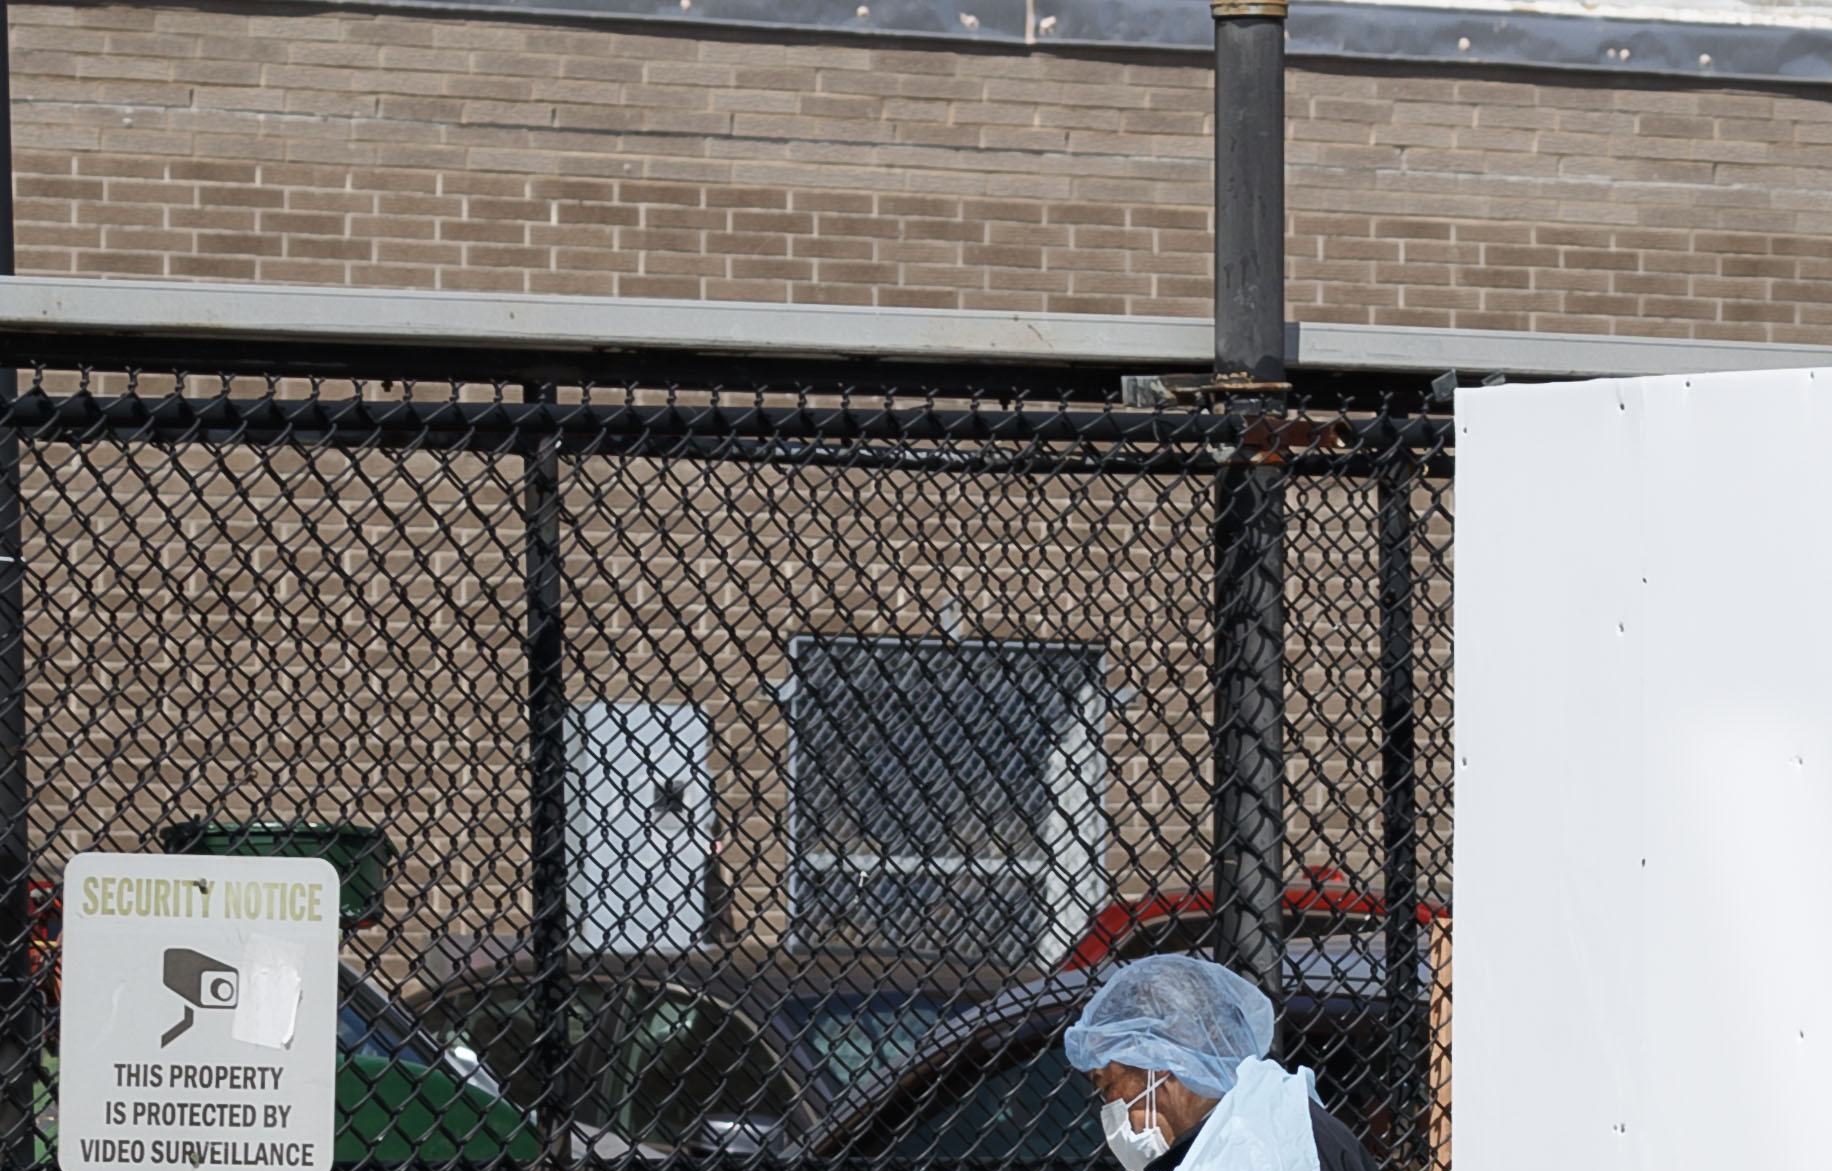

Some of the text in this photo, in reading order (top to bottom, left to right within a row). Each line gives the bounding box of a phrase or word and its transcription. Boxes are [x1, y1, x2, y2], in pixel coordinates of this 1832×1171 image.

[82, 877, 323, 921] SECURITY NOTICE
[114, 1064, 284, 1091] THIS PROPERTY
[105, 1101, 292, 1129] IS PROTECTED BY
[80, 1139, 314, 1167] VIDEO SURVEILLANCE
